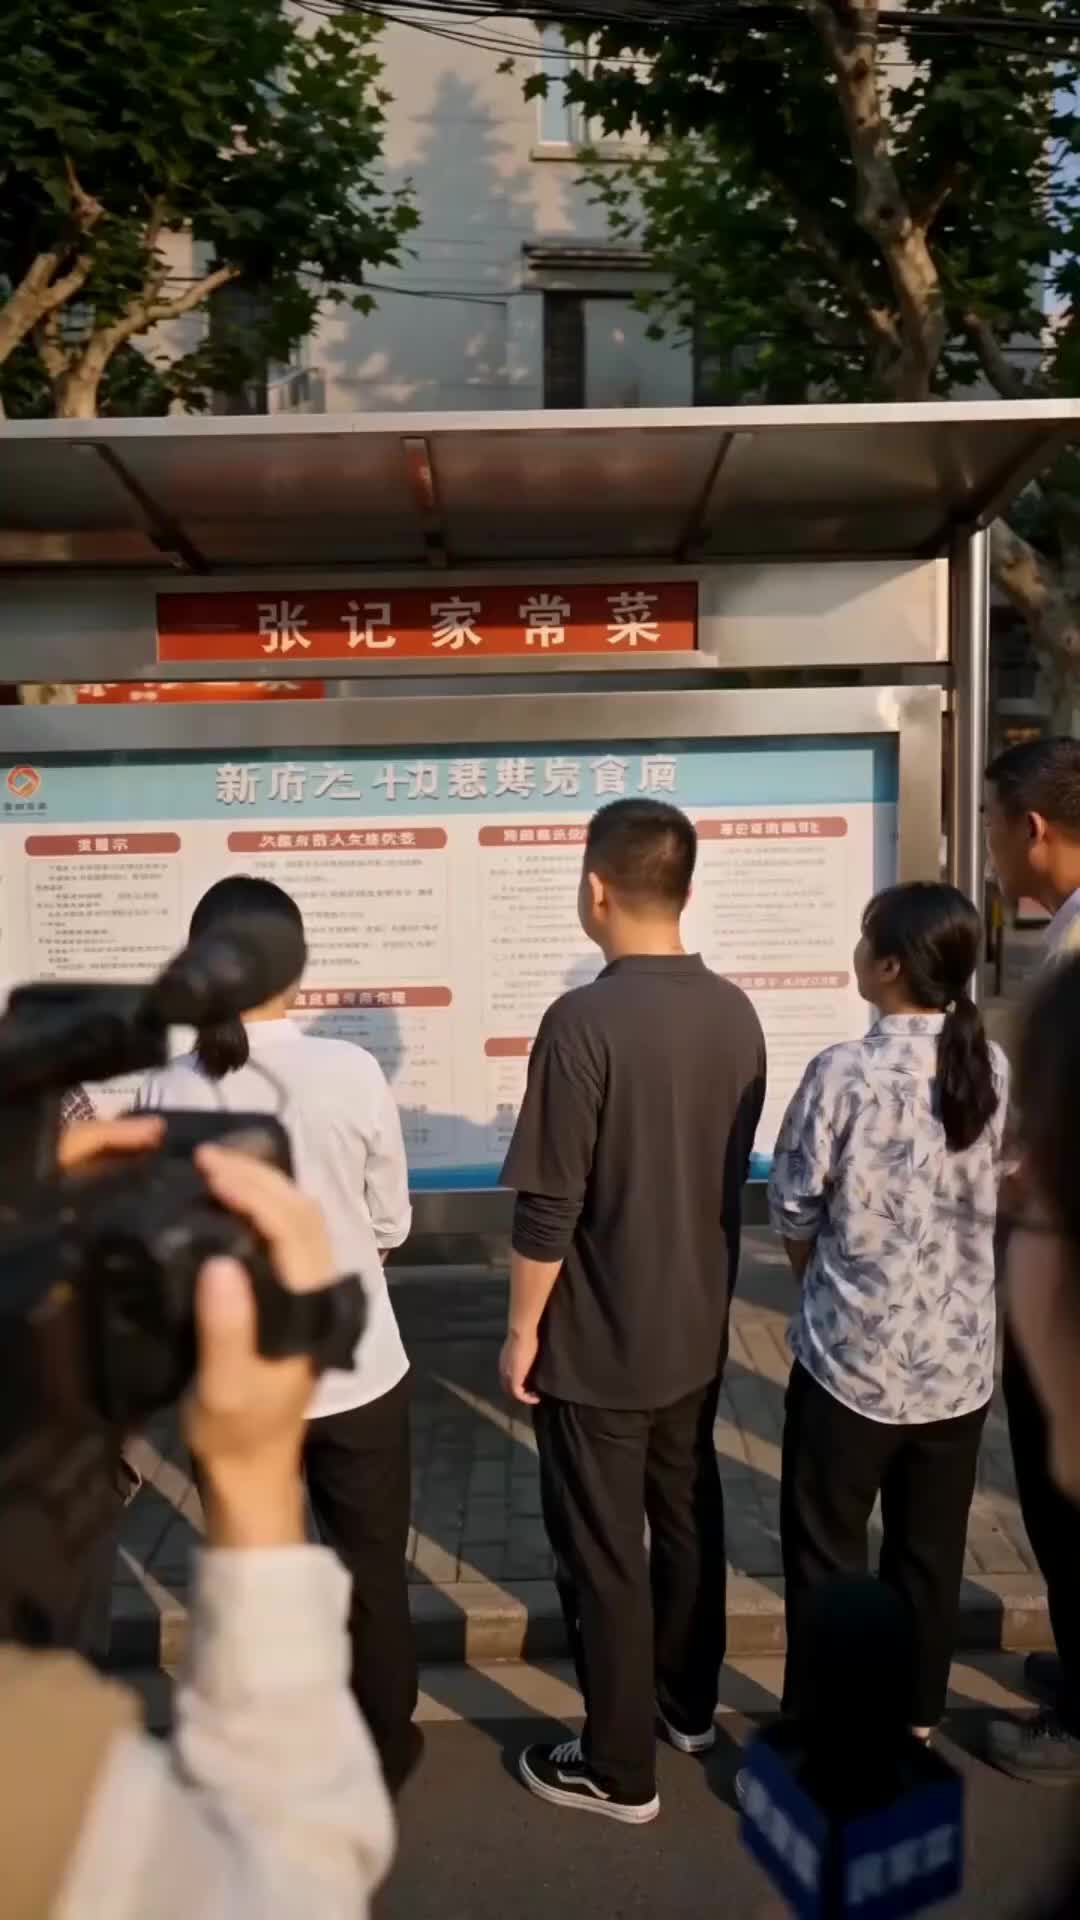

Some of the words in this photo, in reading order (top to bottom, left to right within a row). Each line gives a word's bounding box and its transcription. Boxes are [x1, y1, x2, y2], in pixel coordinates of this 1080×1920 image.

[257, 591, 661, 653] 张记家常菜
